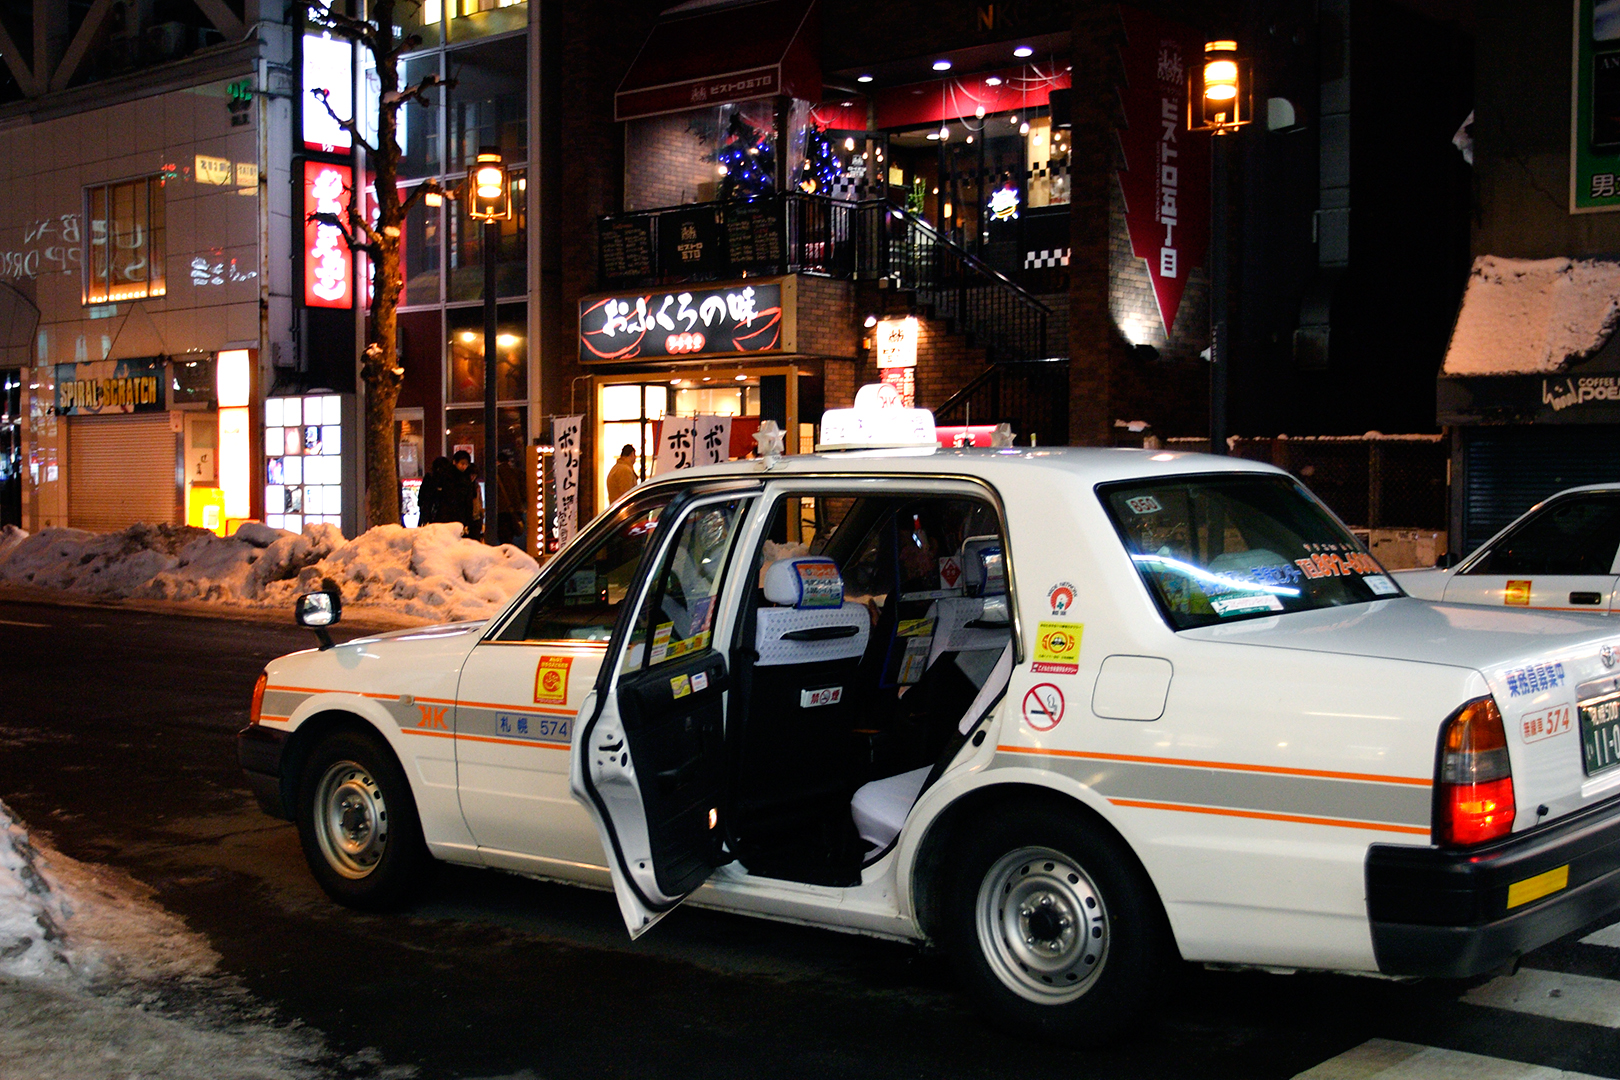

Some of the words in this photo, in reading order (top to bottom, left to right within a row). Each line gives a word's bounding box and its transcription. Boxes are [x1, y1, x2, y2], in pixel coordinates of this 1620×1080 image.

[602, 286, 759, 338] おふくろの味
[1578, 377, 1615, 387] COFFEE
[60, 379, 98, 408] SPIRAL
[102, 376, 157, 407] SCRATCH
[1578, 385, 1620, 404] POE
[1134, 497, 1159, 513] 850
[540, 720, 568, 737] 574
[1546, 707, 1570, 735] 574
